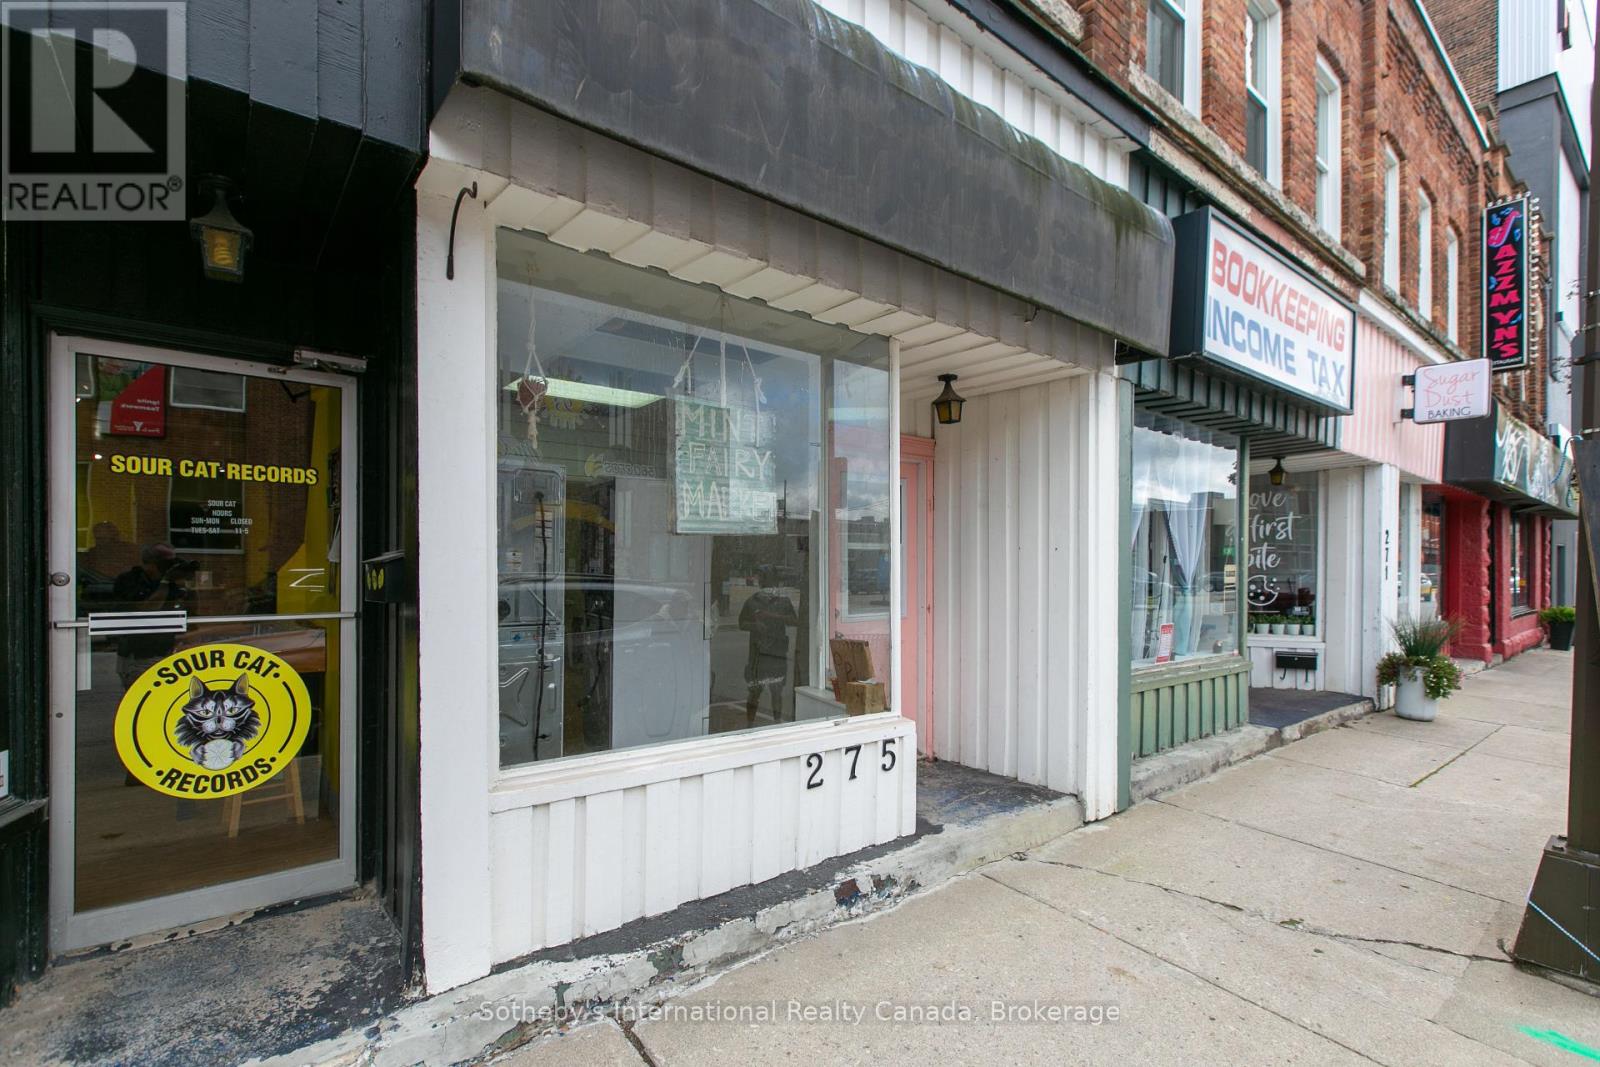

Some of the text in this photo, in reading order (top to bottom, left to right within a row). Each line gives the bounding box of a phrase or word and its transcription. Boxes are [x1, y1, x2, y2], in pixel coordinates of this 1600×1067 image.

[1211, 238, 1345, 352] BOOKKEEPING
[1207, 296, 1345, 397] INCOME TAX
[1423, 368, 1480, 395] Sugar
[1424, 386, 1474, 408] Dust
[1428, 406, 1472, 419] BAKING
[110, 454, 318, 485] SOUR CAT RECORDS
[207, 499, 237, 508] SOUR CAT
[212, 509, 233, 517] HOURS
[1248, 489, 1288, 509] ove
[230, 518, 253, 526] CLOSED
[1250, 511, 1302, 542] first
[157, 650, 280, 685] SOUR CAT
[159, 757, 273, 794] RECORDS
[806, 738, 896, 790] 275
